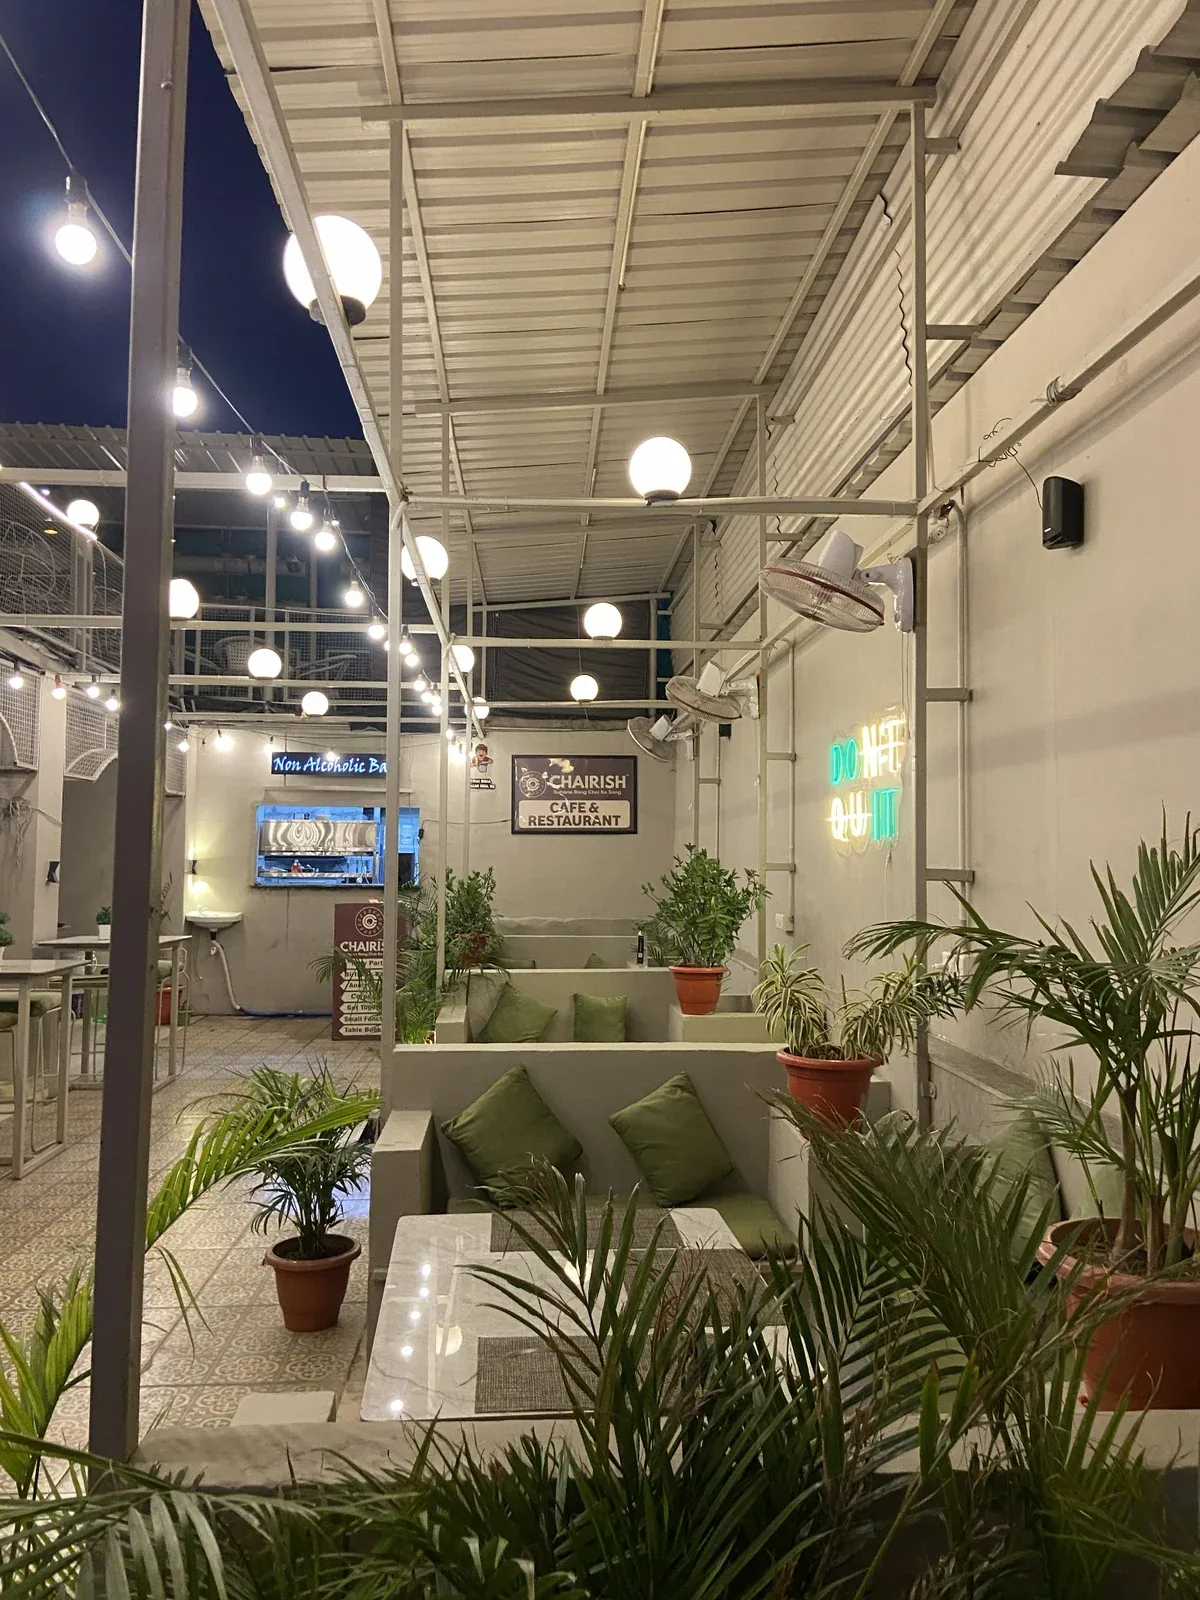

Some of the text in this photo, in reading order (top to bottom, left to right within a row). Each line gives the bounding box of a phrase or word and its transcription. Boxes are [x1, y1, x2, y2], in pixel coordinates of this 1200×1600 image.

[273, 755, 387, 774] Non Alcoholic Ba
[549, 774, 627, 789] CHAIRISH
[549, 802, 599, 813] CAFE &
[829, 788, 902, 842] QUIT
[528, 815, 621, 826] RESTAURANT
